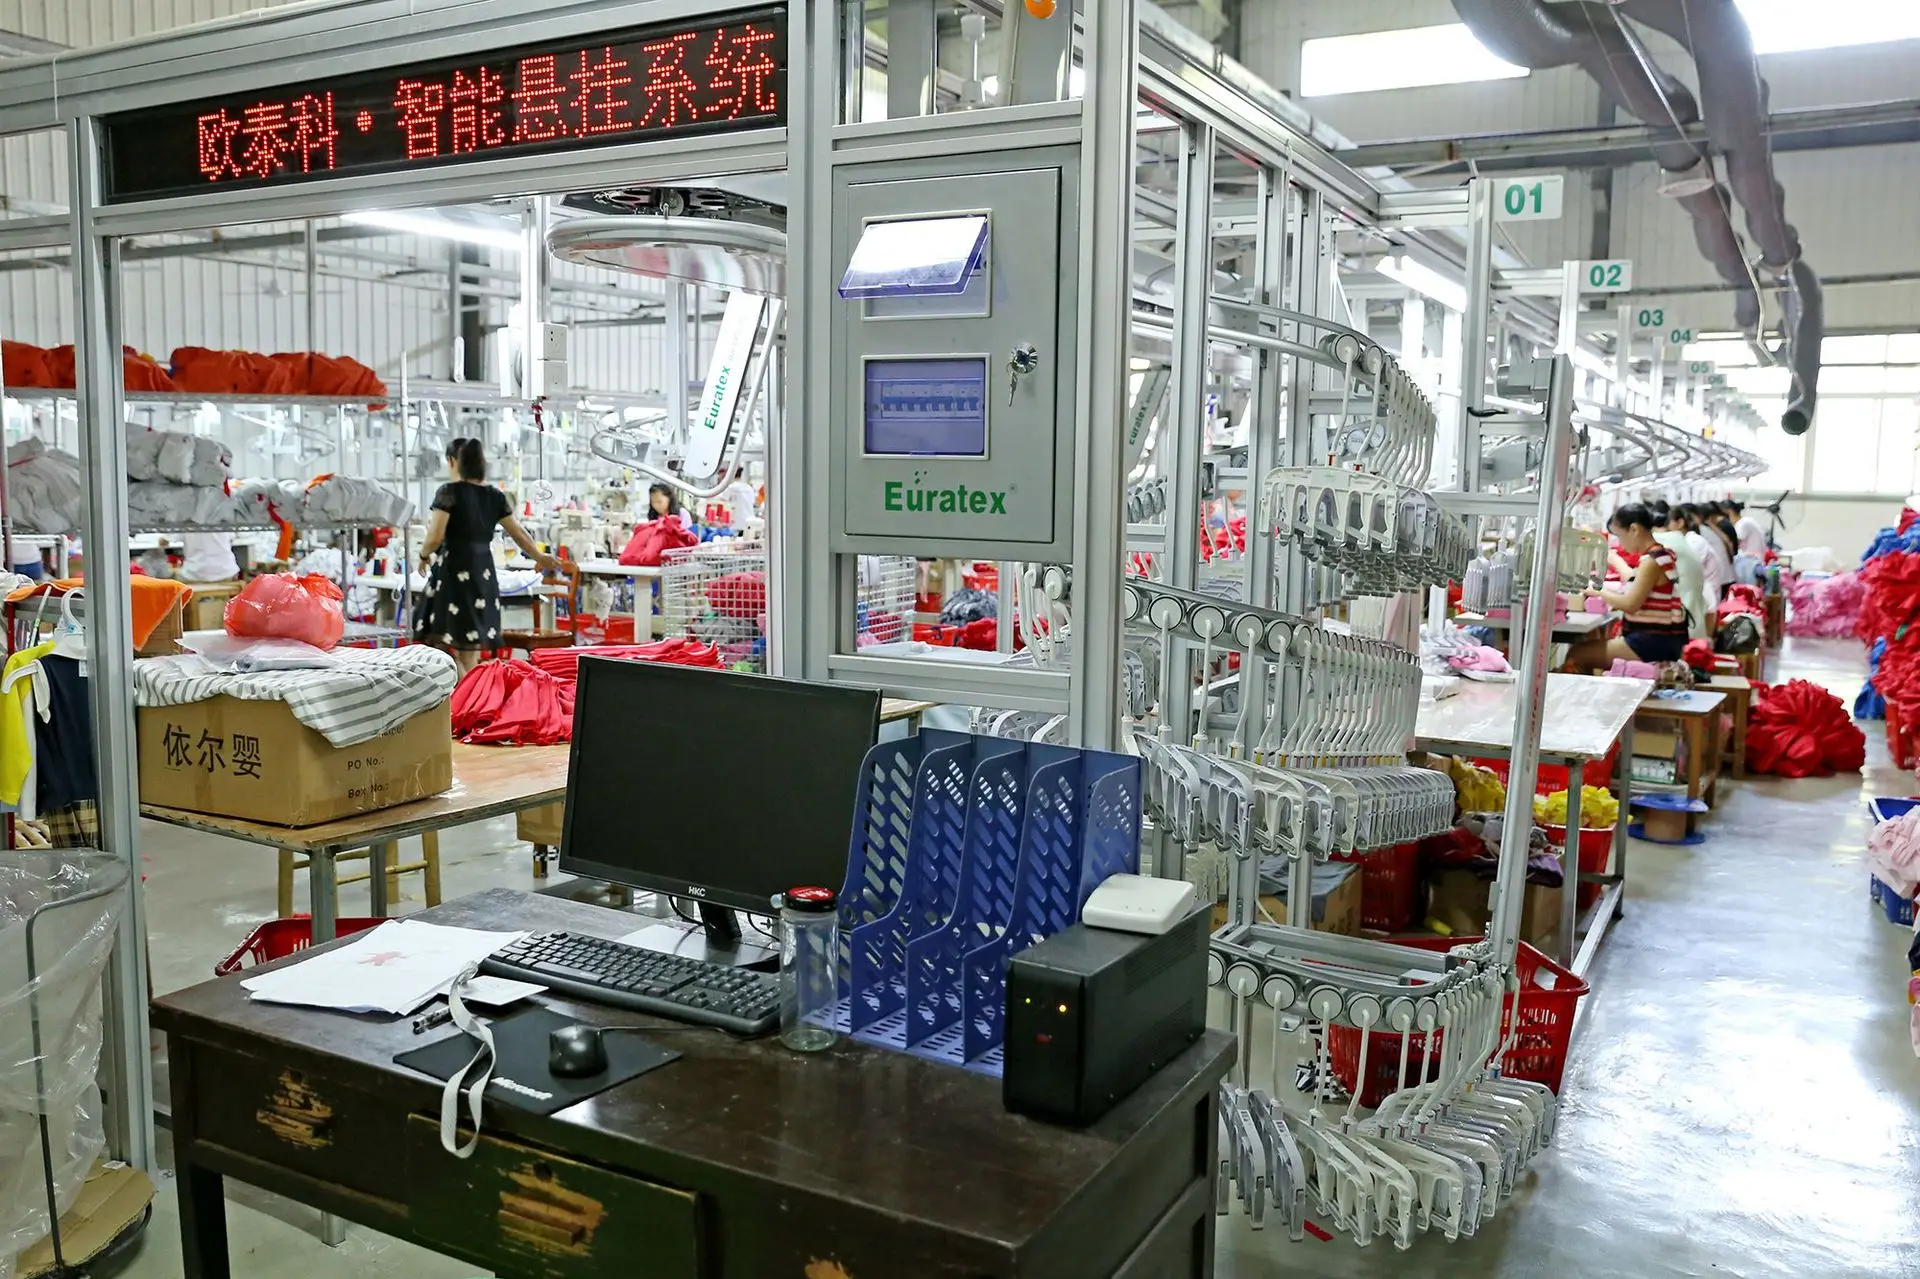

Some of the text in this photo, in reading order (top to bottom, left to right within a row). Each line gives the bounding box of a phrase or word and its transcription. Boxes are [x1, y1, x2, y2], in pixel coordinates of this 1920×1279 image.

[1504, 181, 1543, 215] 01
[1589, 264, 1622, 287] 02
[1638, 308, 1664, 327] 03
[1671, 329, 1691, 344] 04
[1690, 362, 1710, 374] 05
[704, 365, 731, 430] Euratex
[884, 480, 1007, 515] Euratex
[162, 722, 263, 780] 依尔婴
[347, 755, 385, 771] PO No.:
[688, 885, 706, 897] HKC
